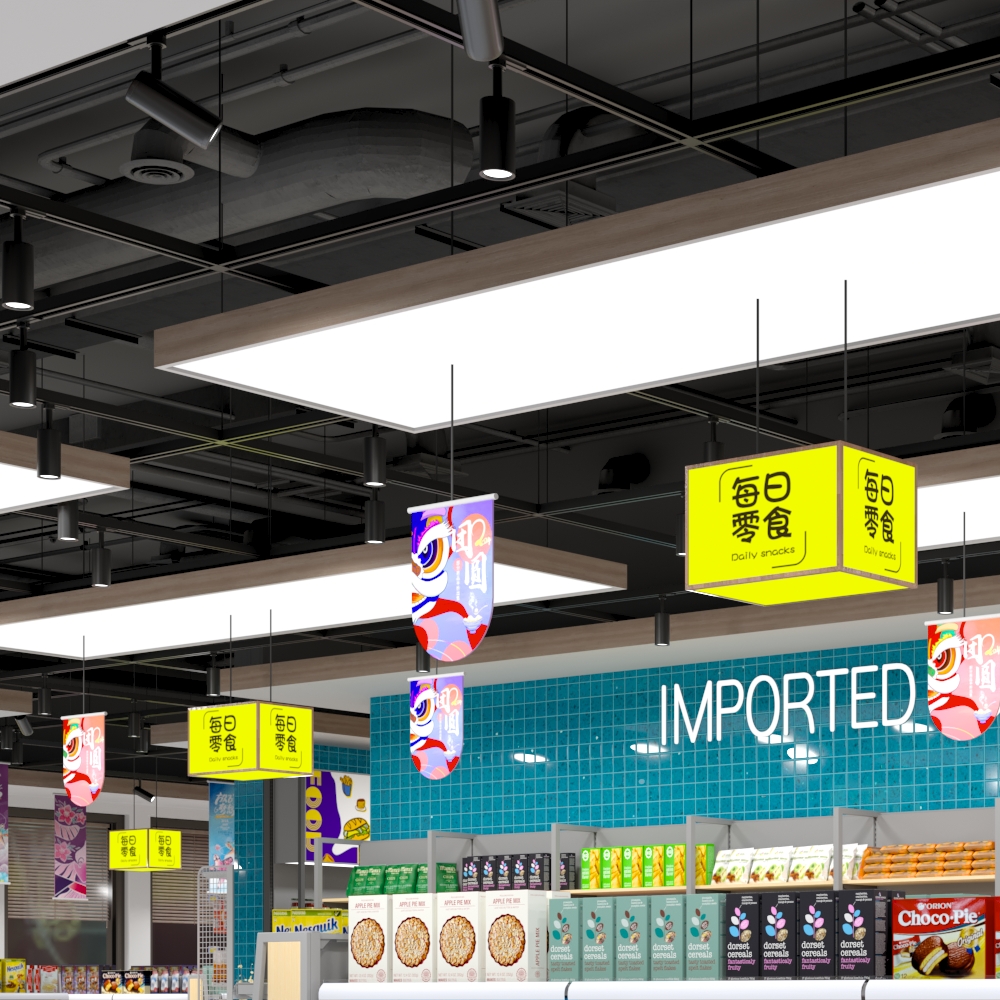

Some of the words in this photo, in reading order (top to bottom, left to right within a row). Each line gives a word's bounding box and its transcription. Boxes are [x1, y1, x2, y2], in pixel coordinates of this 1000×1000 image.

[732, 471, 791, 508] 每日
[865, 469, 894, 506] 每日
[732, 506, 792, 543] 零食
[865, 505, 894, 544] 零食
[731, 551, 758, 561] Daily
[761, 547, 795, 557] snacks
[864, 545, 877, 557] Daily
[879, 551, 896, 560] snacks
[661, 662, 917, 745] IMPORTED
[209, 715, 236, 733] 每日
[275, 714, 296, 732] 每日
[209, 734, 236, 752] 零食
[275, 734, 297, 753] 零食
[121, 835, 136, 845] 每日
[159, 835, 171, 845] 每日
[925, 902, 952, 910] ORION
[957, 929, 984, 947] Original
[551, 945, 570, 953] dorset
[584, 944, 604, 952] dorset
[653, 943, 674, 951] dorset
[728, 942, 750, 950] dorset
[802, 949, 827, 957] cereals
[841, 948, 867, 956] cereals
[728, 950, 753, 958] cereals
